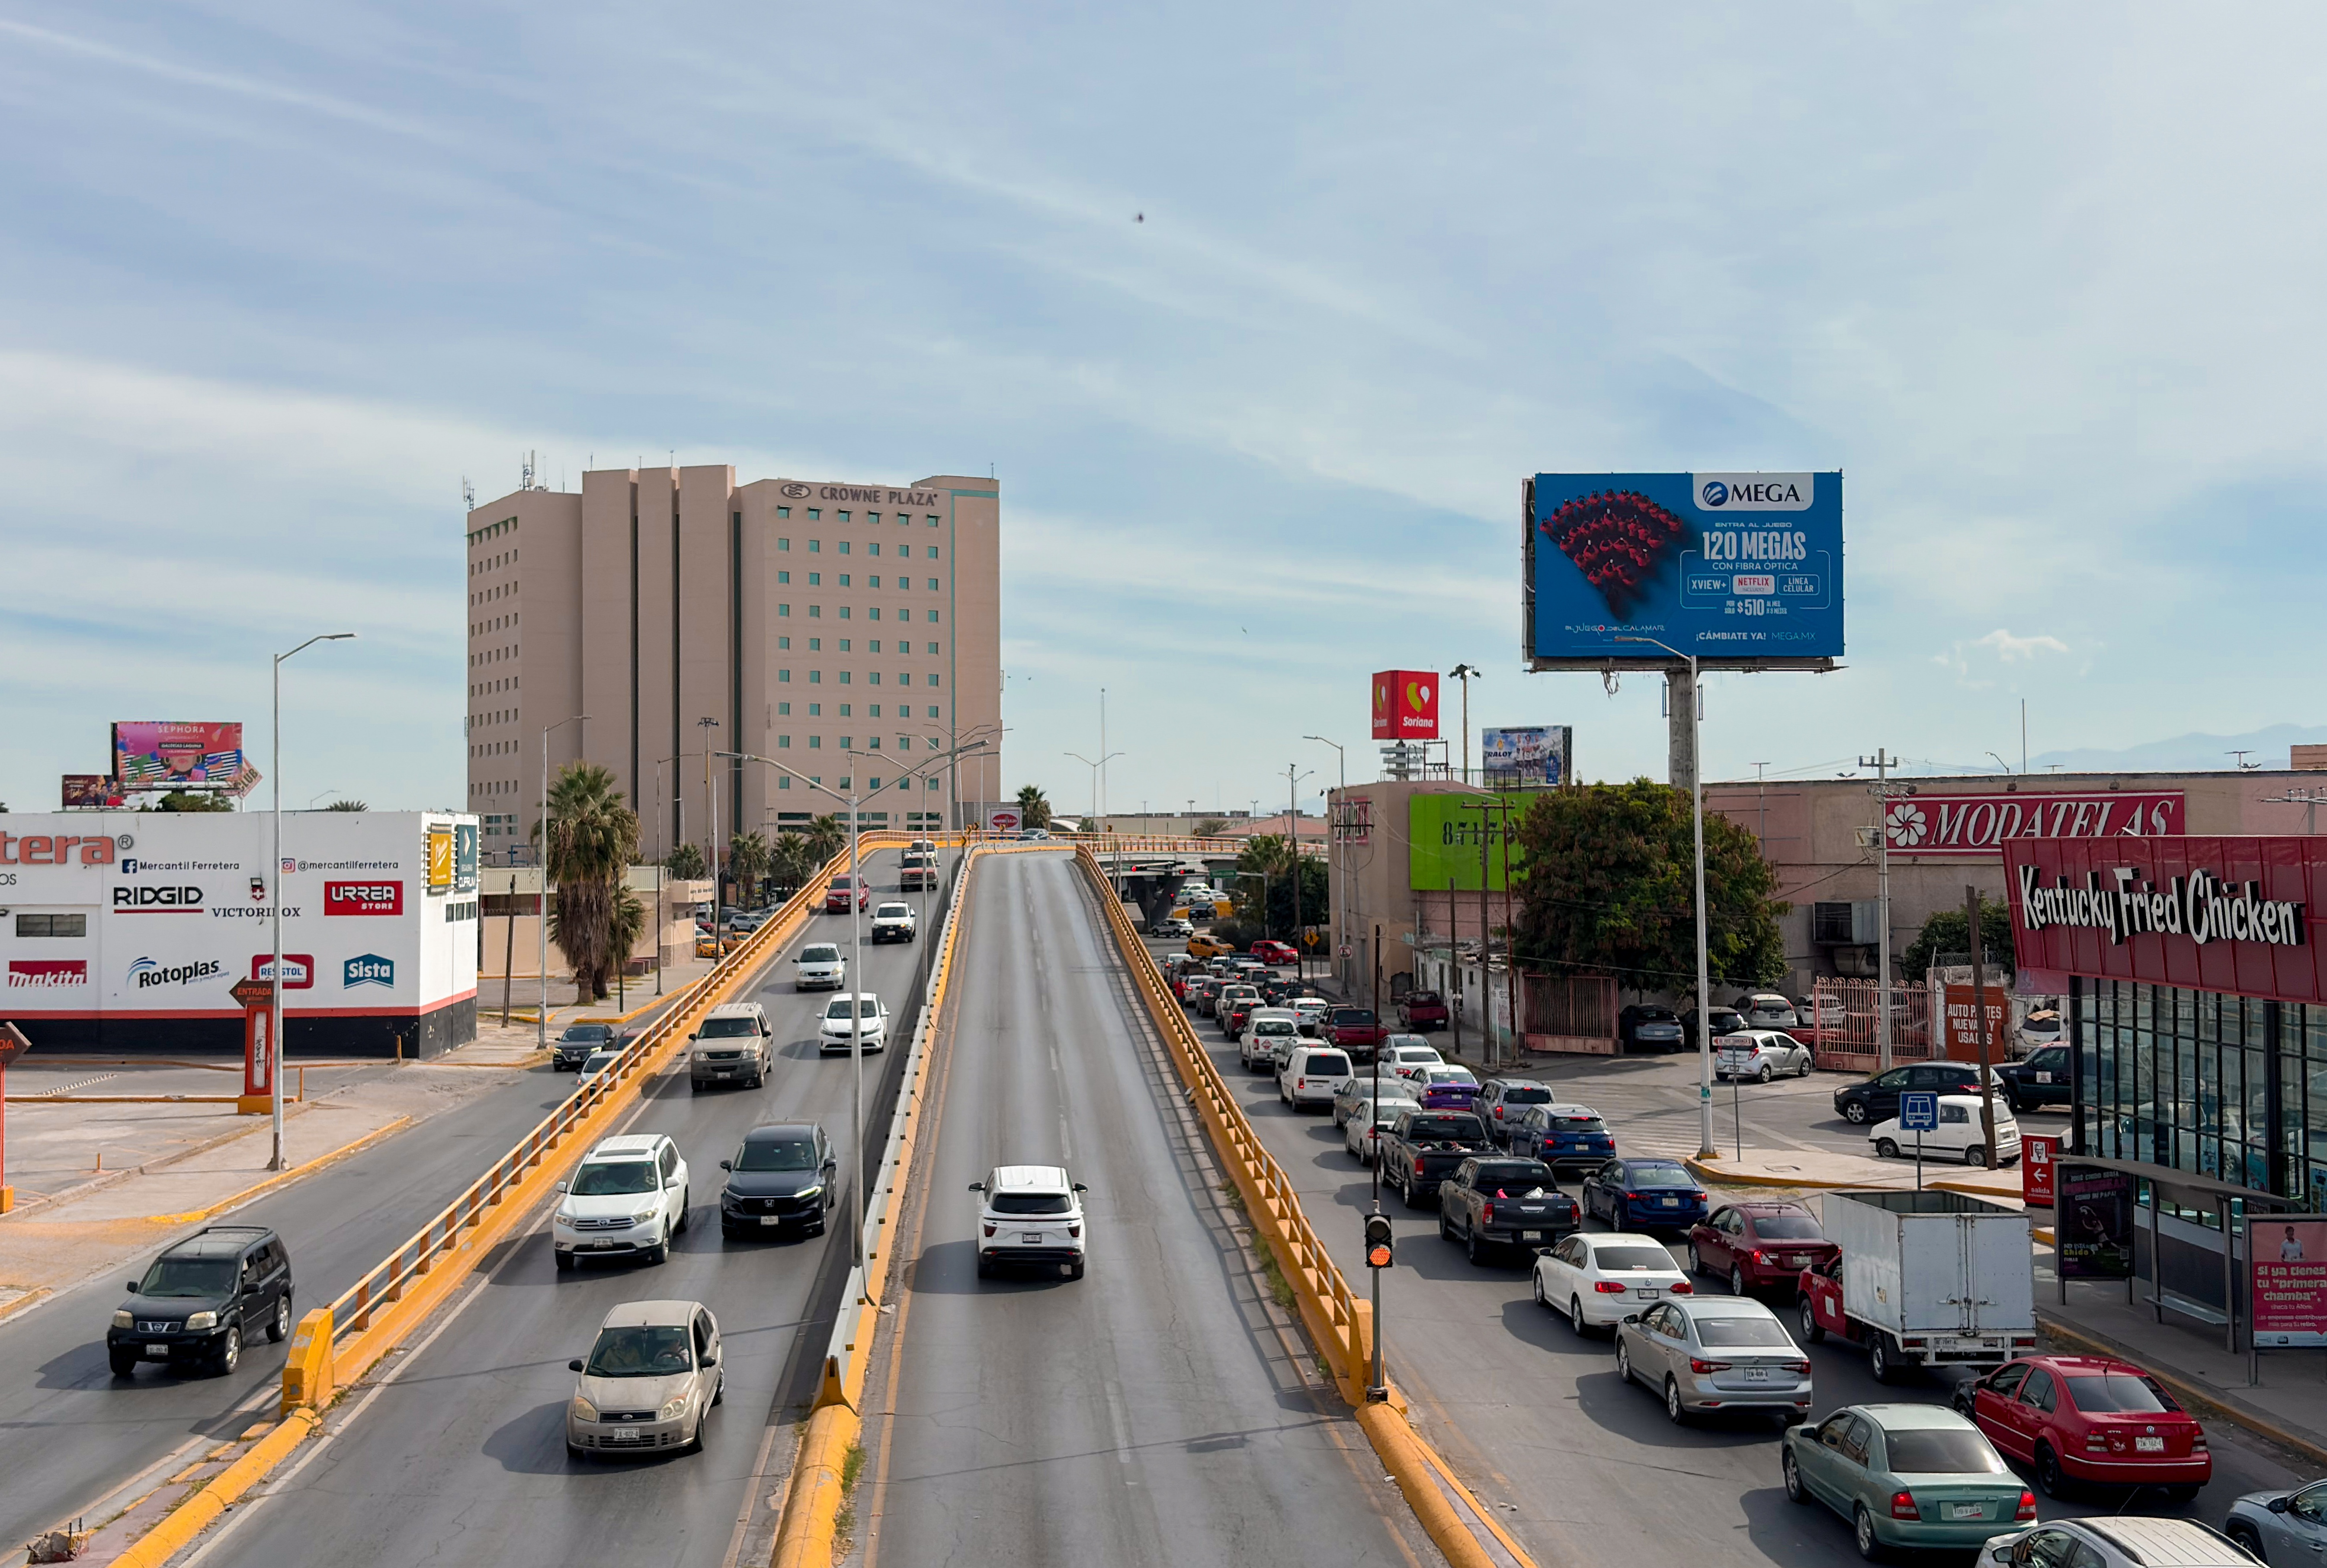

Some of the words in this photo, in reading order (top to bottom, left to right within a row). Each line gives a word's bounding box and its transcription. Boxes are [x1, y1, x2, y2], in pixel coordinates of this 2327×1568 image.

[821, 486, 880, 503] CROWNE
[889, 491, 935, 506] PLAZA
[1731, 483, 1801, 502] MEGA
[1702, 531, 1737, 560] 120
[1741, 531, 1806, 560] MEGAS
[1764, 560, 1798, 570] ÓPTICA
[1692, 579, 1726, 589] XVIEW+
[1738, 577, 1769, 586] NETFLIX
[1750, 632, 1766, 640] YA!
[1772, 632, 1816, 640] MEGA.MX
[1403, 716, 1433, 728] Soriana
[1930, 800, 2175, 845] MODATELAS
[140, 861, 189, 870] Mercantil
[192, 861, 239, 870] Ferretera
[298, 861, 398, 872] @mercantilferretera
[113, 886, 203, 905] RIDGID
[331, 886, 394, 902] URREA
[2019, 865, 2119, 946] Kentucky
[2112, 867, 2183, 937] Fried
[2187, 868, 2297, 946] Chicken
[139, 960, 219, 988] Rotoplas
[349, 960, 391, 978] Sista
[237, 987, 272, 995] ENTRADA
[1948, 1003, 1968, 1017] AUTO
[1971, 1005, 2001, 1019] PTES
[1953, 1018, 1978, 1030] NUEVA
[1989, 1020, 1995, 1031] Y
[2271, 1267, 2287, 1276] ya
[2290, 1266, 2326, 1275] tienes
[2257, 1279, 2269, 1288] tu
